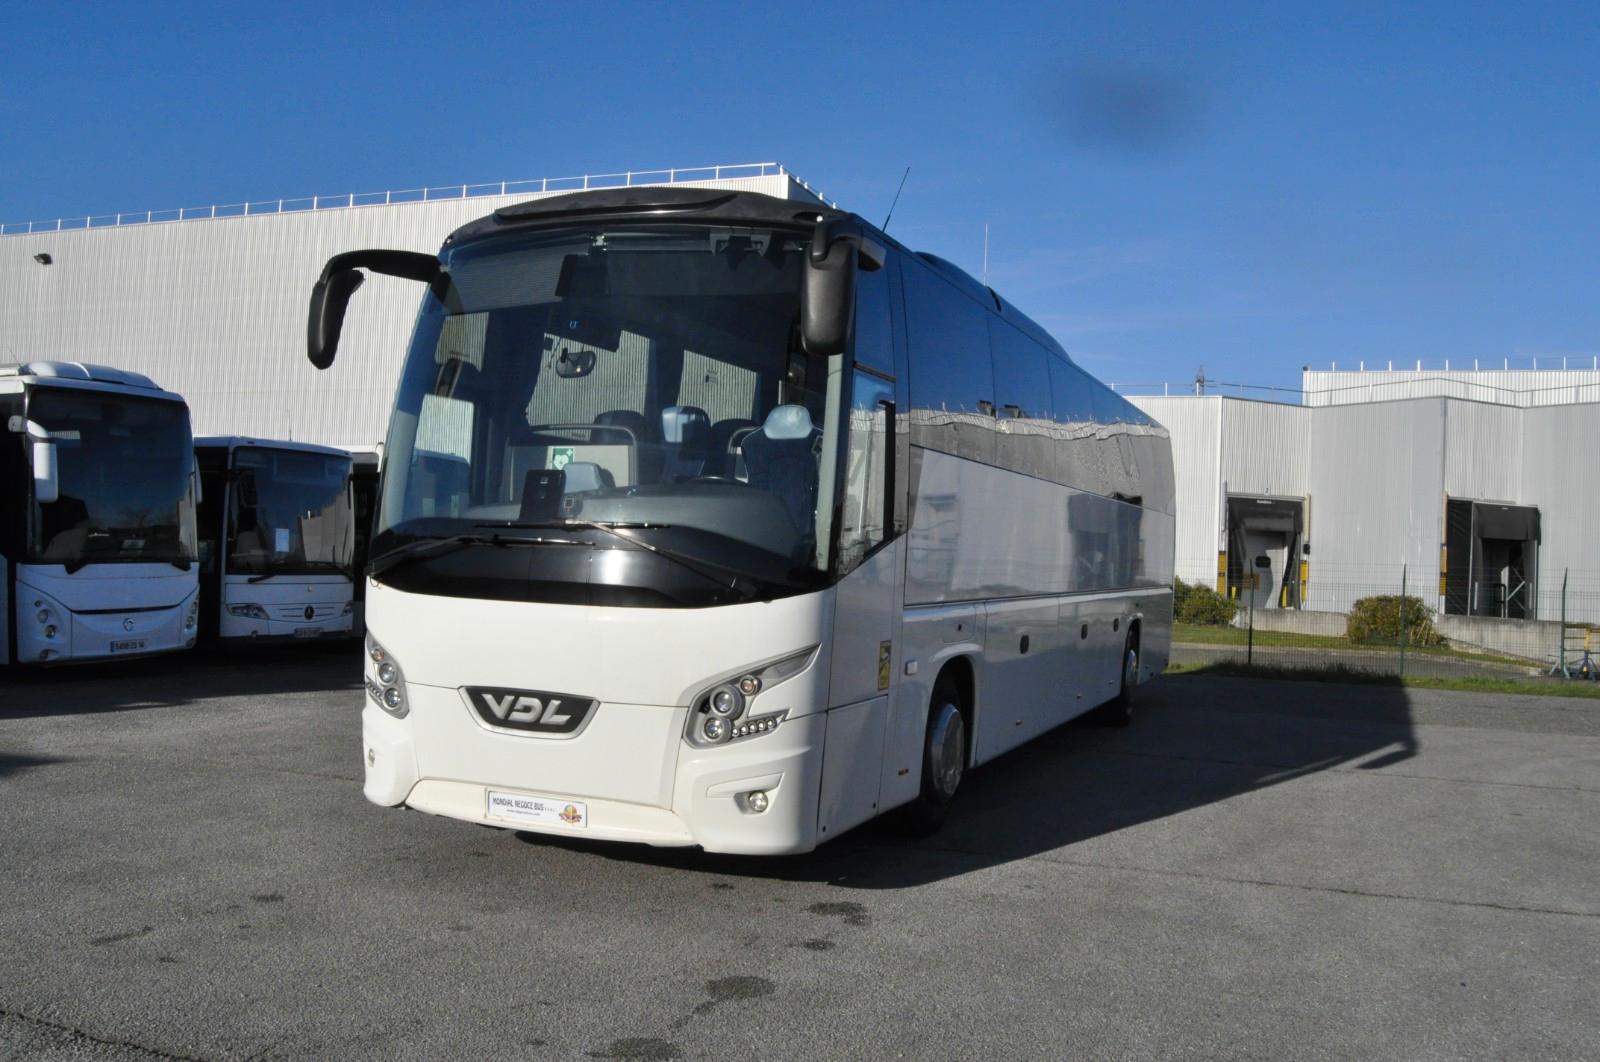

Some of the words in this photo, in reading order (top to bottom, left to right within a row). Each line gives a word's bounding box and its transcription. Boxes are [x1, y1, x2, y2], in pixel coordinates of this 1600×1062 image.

[481, 693, 571, 725] VDL
[492, 797, 514, 807] MONDIAL
[534, 802, 545, 812] BUS
